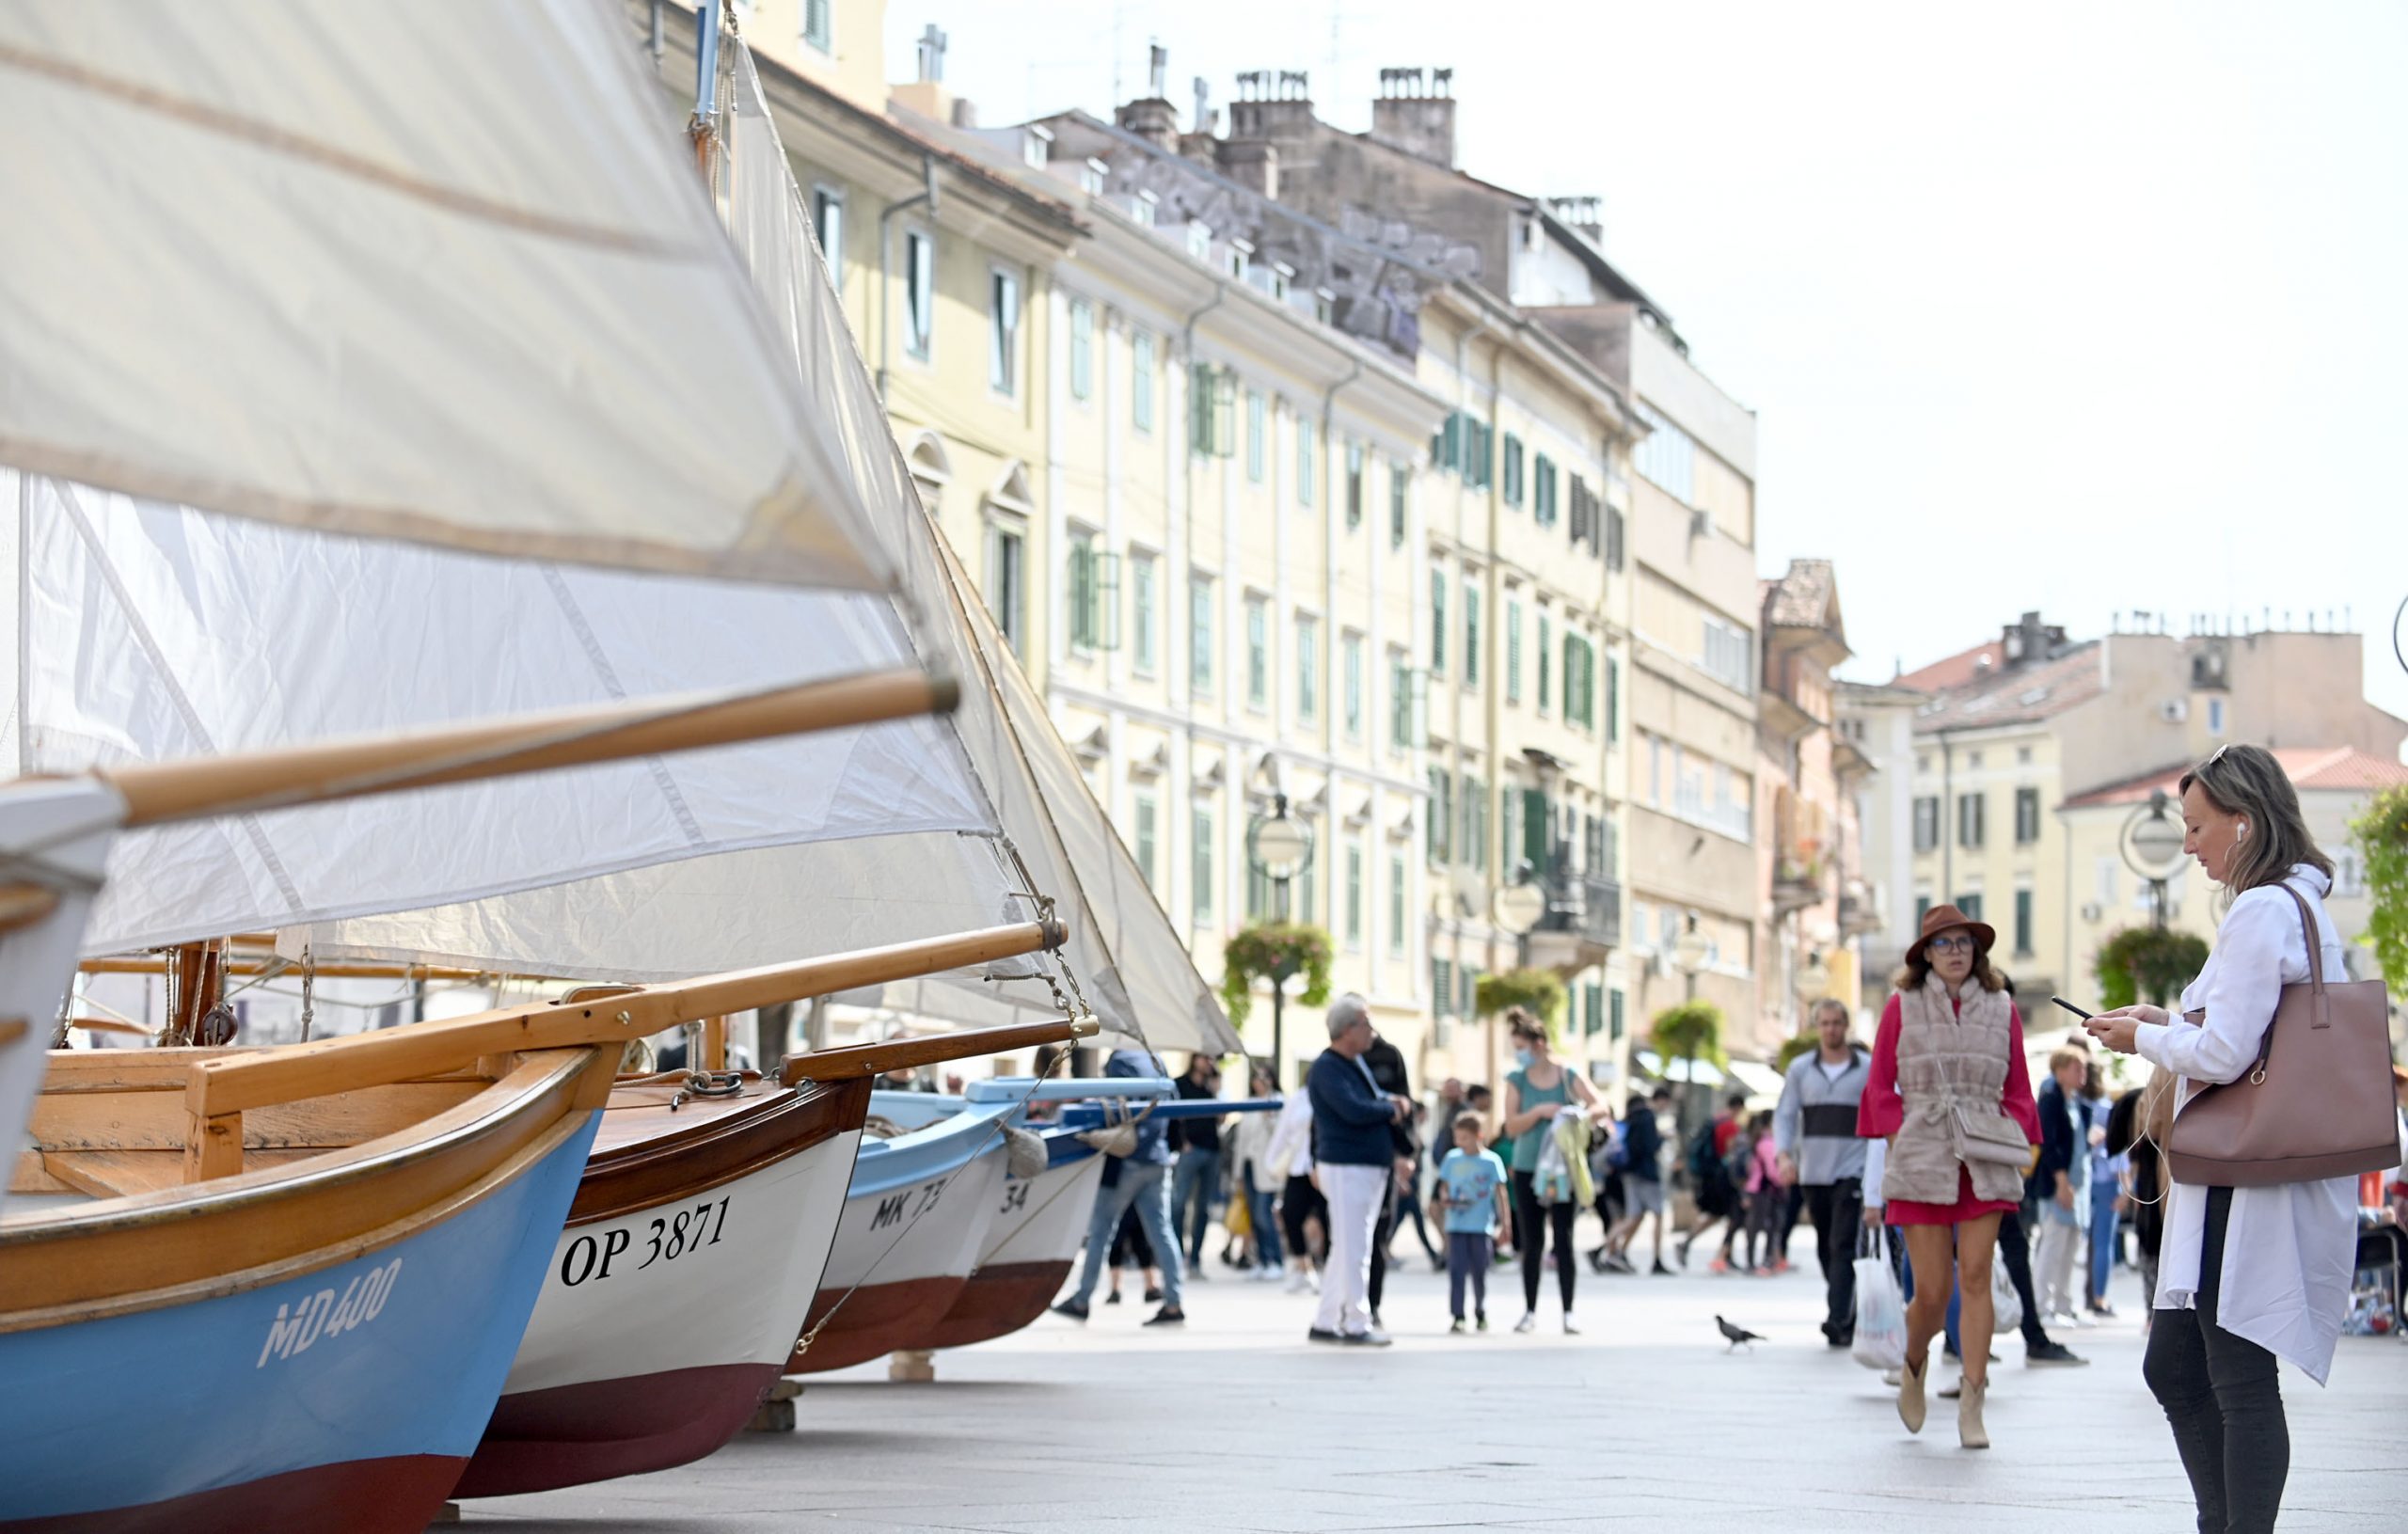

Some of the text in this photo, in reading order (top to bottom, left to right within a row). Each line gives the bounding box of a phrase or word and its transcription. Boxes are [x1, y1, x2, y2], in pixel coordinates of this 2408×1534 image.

[561, 1195, 731, 1287] OP 3871
[870, 1191, 912, 1231] MK
[257, 1257, 403, 1368] MD400
